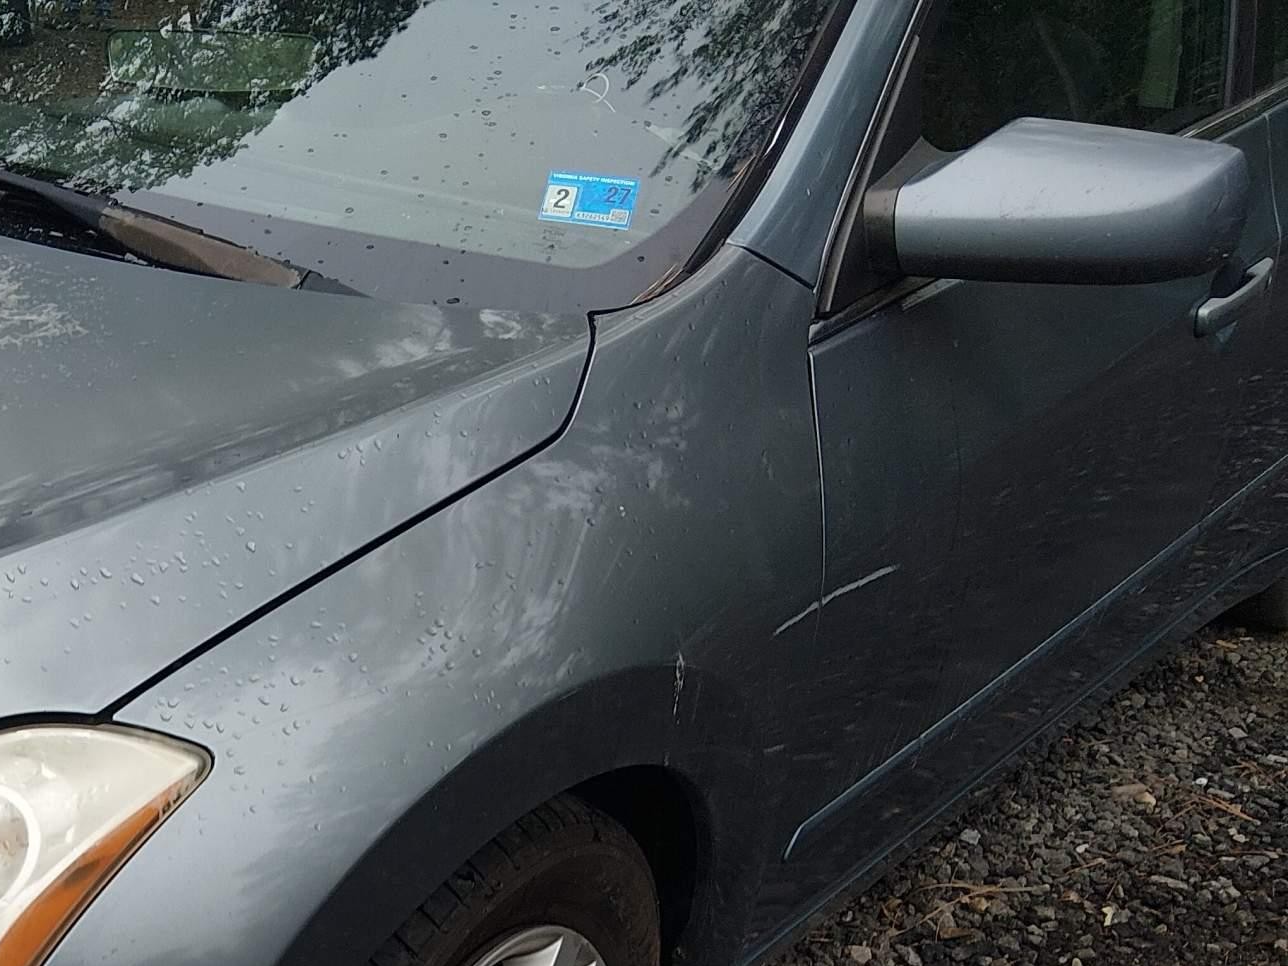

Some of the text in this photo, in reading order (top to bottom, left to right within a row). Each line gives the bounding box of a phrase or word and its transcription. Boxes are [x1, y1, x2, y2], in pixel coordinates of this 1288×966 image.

[579, 175, 600, 183] SAFETY
[553, 188, 570, 209] 2
[605, 187, 632, 205] 27
